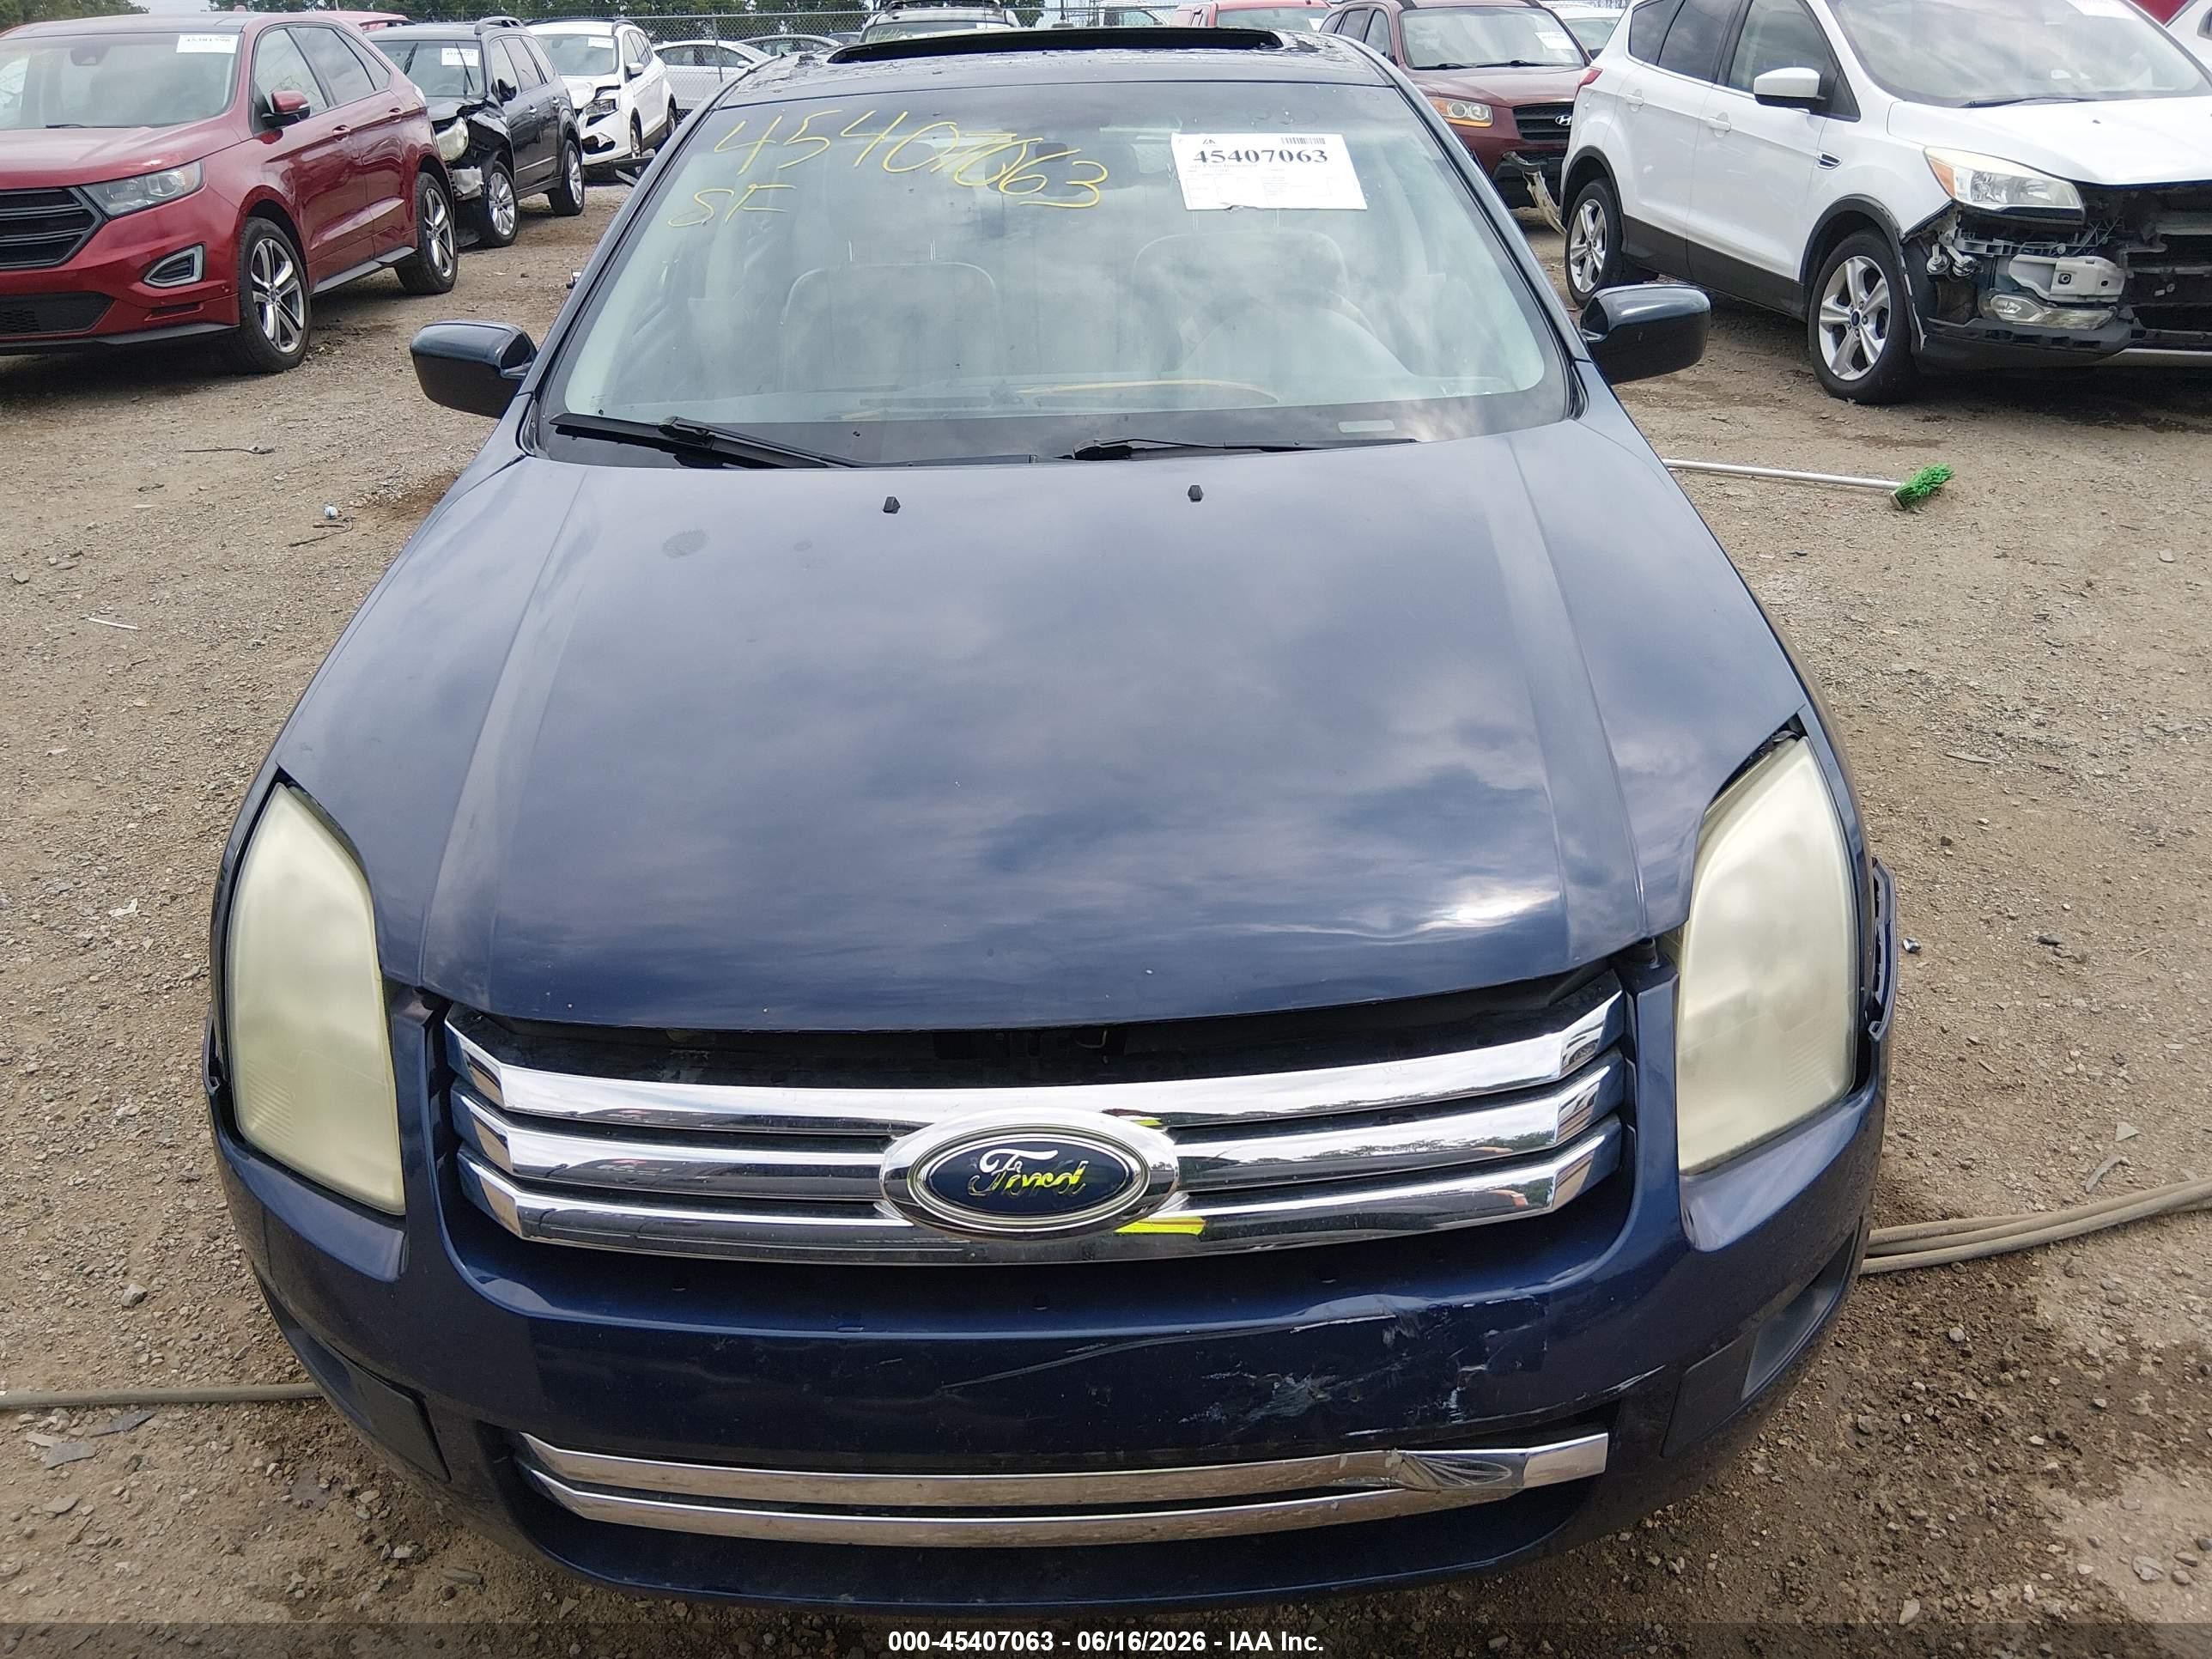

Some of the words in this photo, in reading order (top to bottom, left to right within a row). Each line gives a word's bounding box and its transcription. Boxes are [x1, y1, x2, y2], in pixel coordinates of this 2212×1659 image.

[713, 109, 1109, 208] 45407063
[1193, 149, 1328, 164] 45407063
[667, 183, 797, 228] SF
[968, 1147, 1090, 1197] Ford
